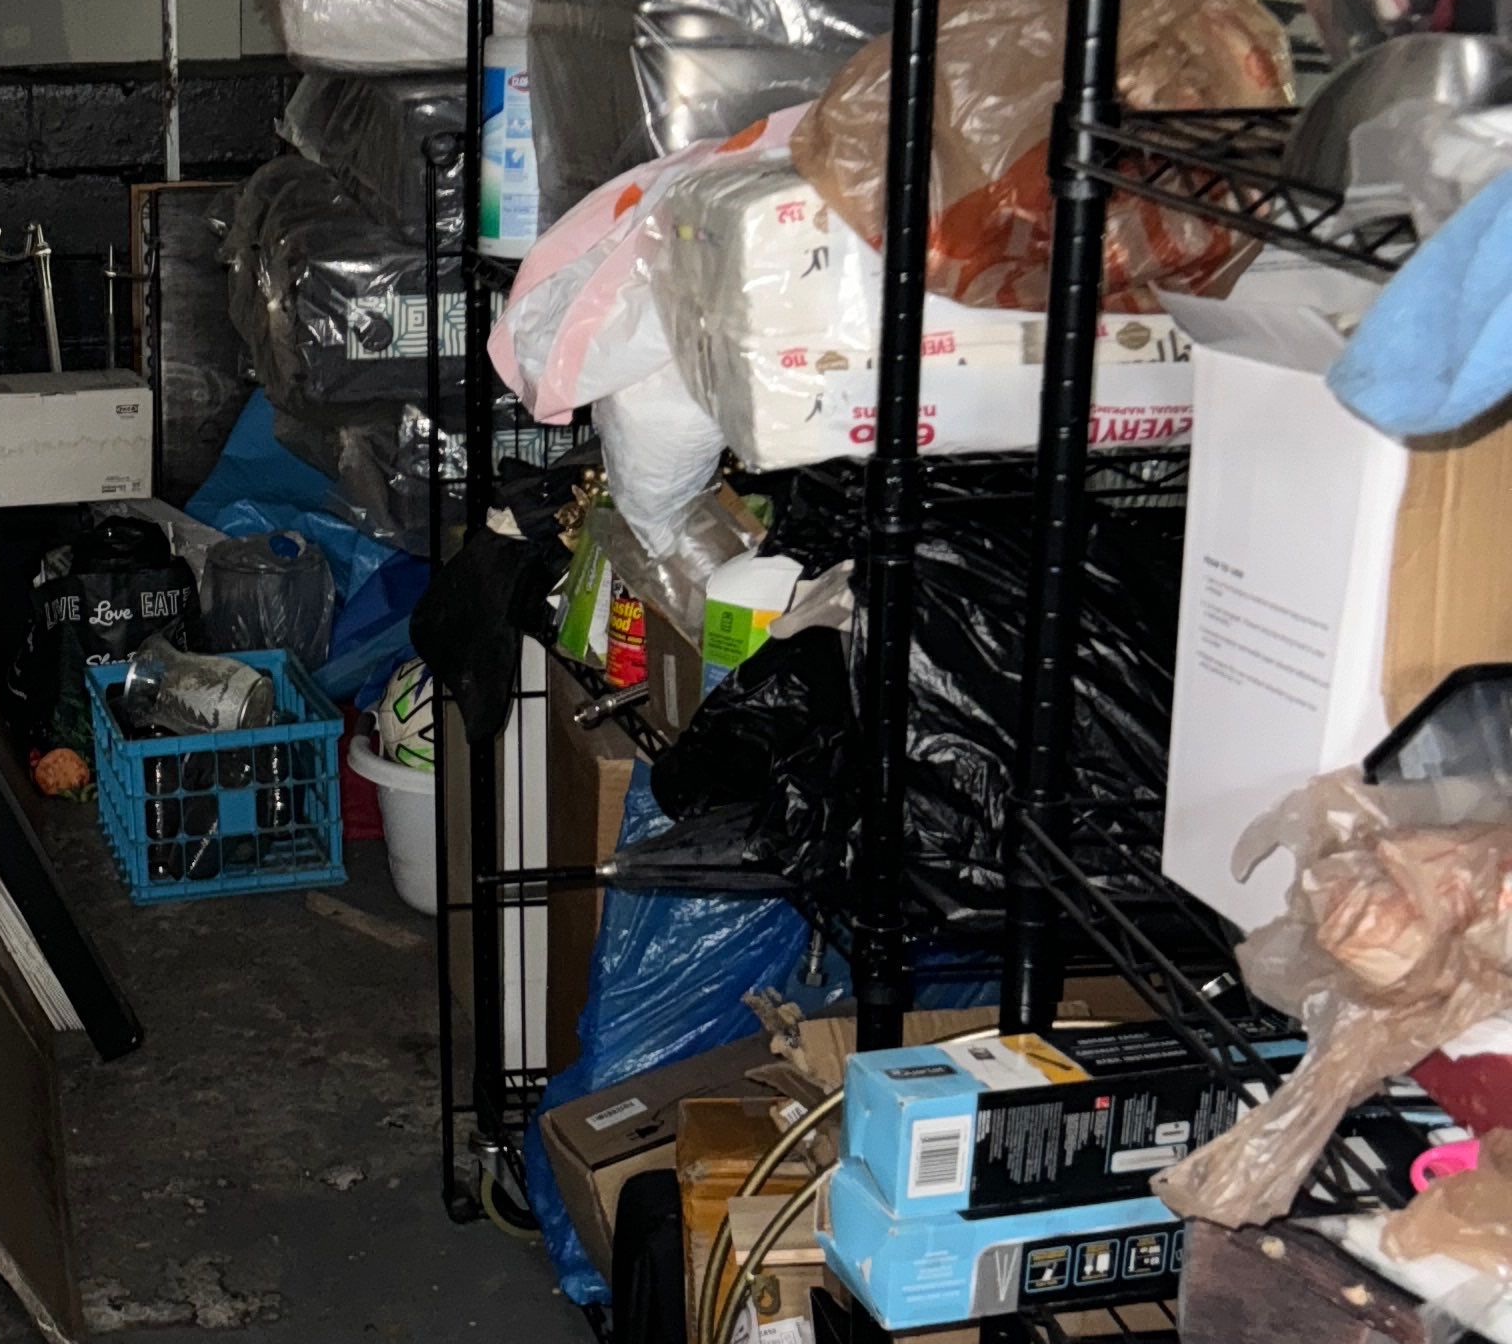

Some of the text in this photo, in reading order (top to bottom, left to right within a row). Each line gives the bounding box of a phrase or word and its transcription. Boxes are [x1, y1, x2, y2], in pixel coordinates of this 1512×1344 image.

[45, 596, 81, 631] LIVE
[89, 600, 133, 626] Love
[141, 589, 180, 618] EAT
